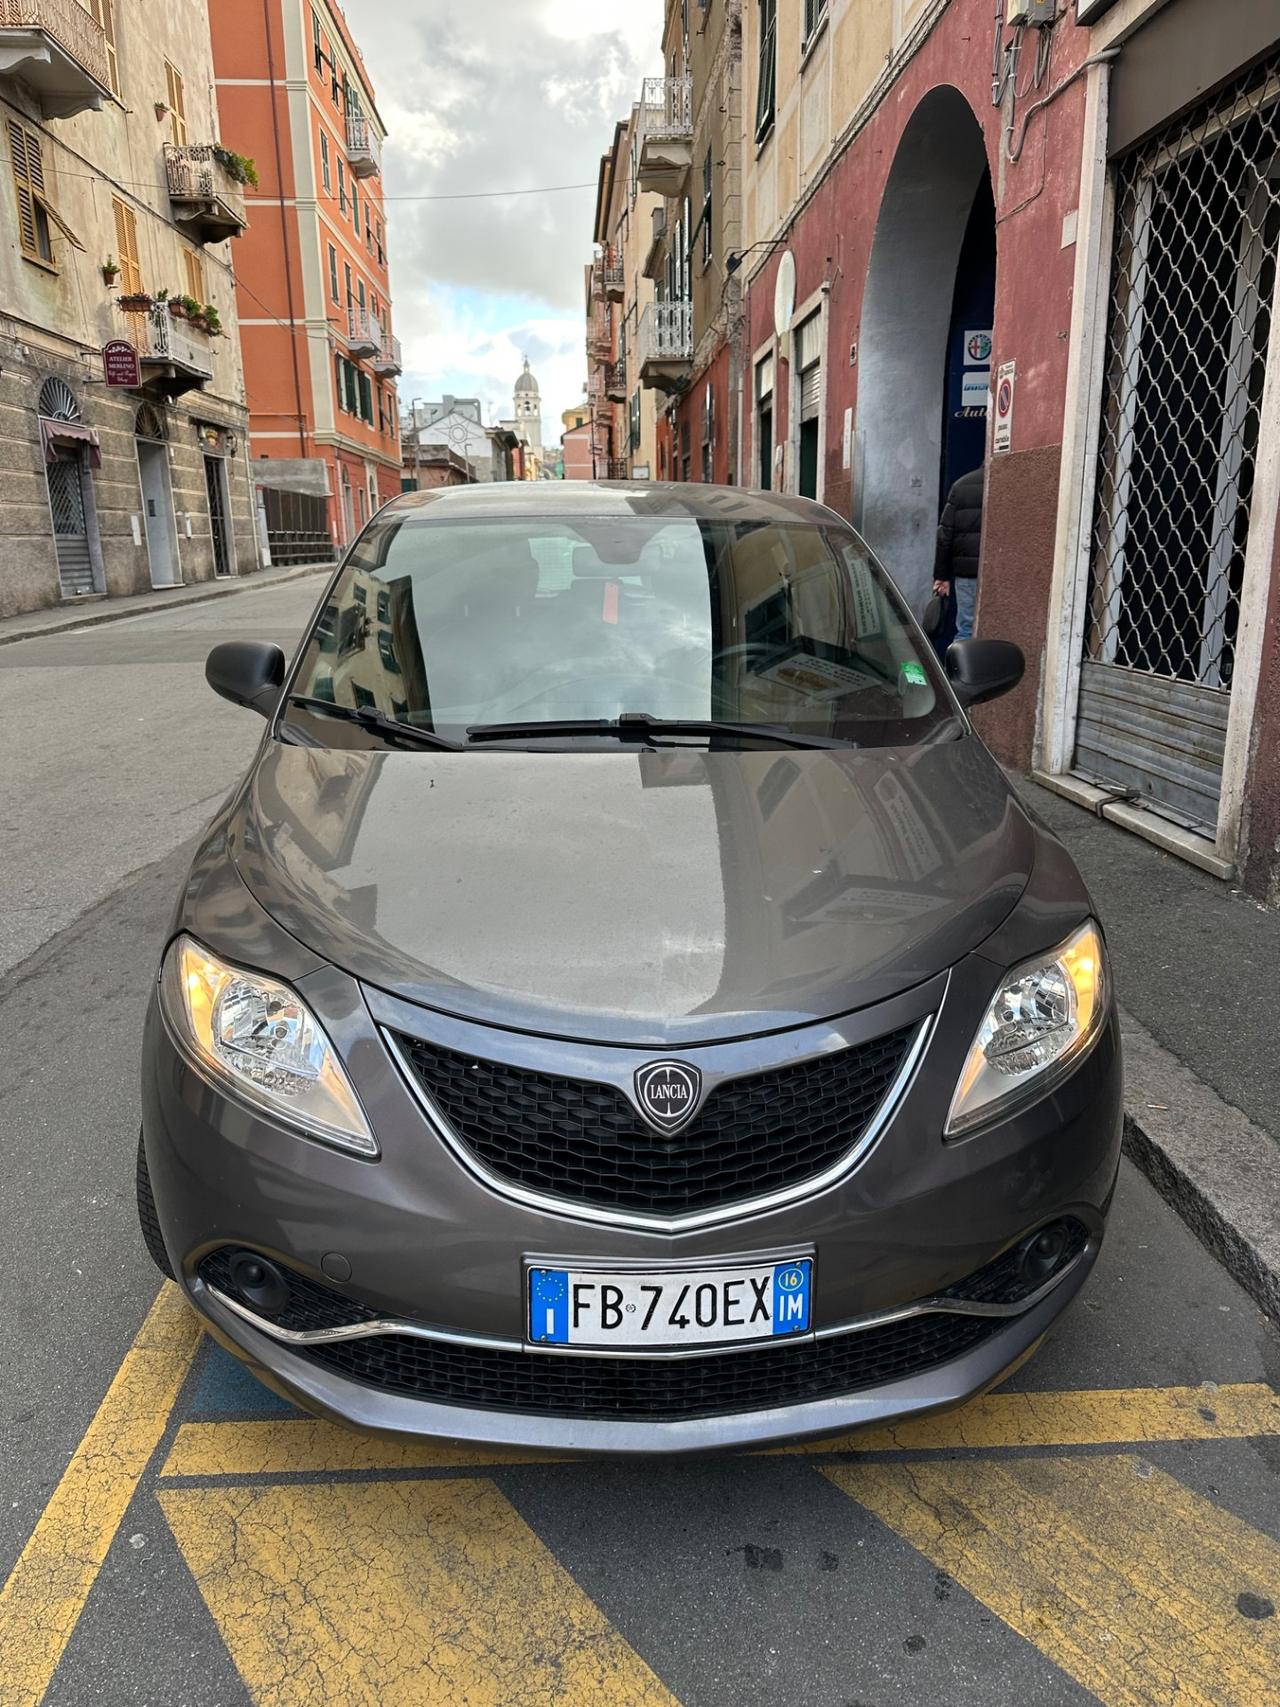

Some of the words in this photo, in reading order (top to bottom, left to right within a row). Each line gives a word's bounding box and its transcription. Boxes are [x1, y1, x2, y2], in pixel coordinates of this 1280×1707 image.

[650, 1084, 688, 1099] LANCIA
[784, 1272, 798, 1287] 16
[779, 1293, 803, 1322] IM
